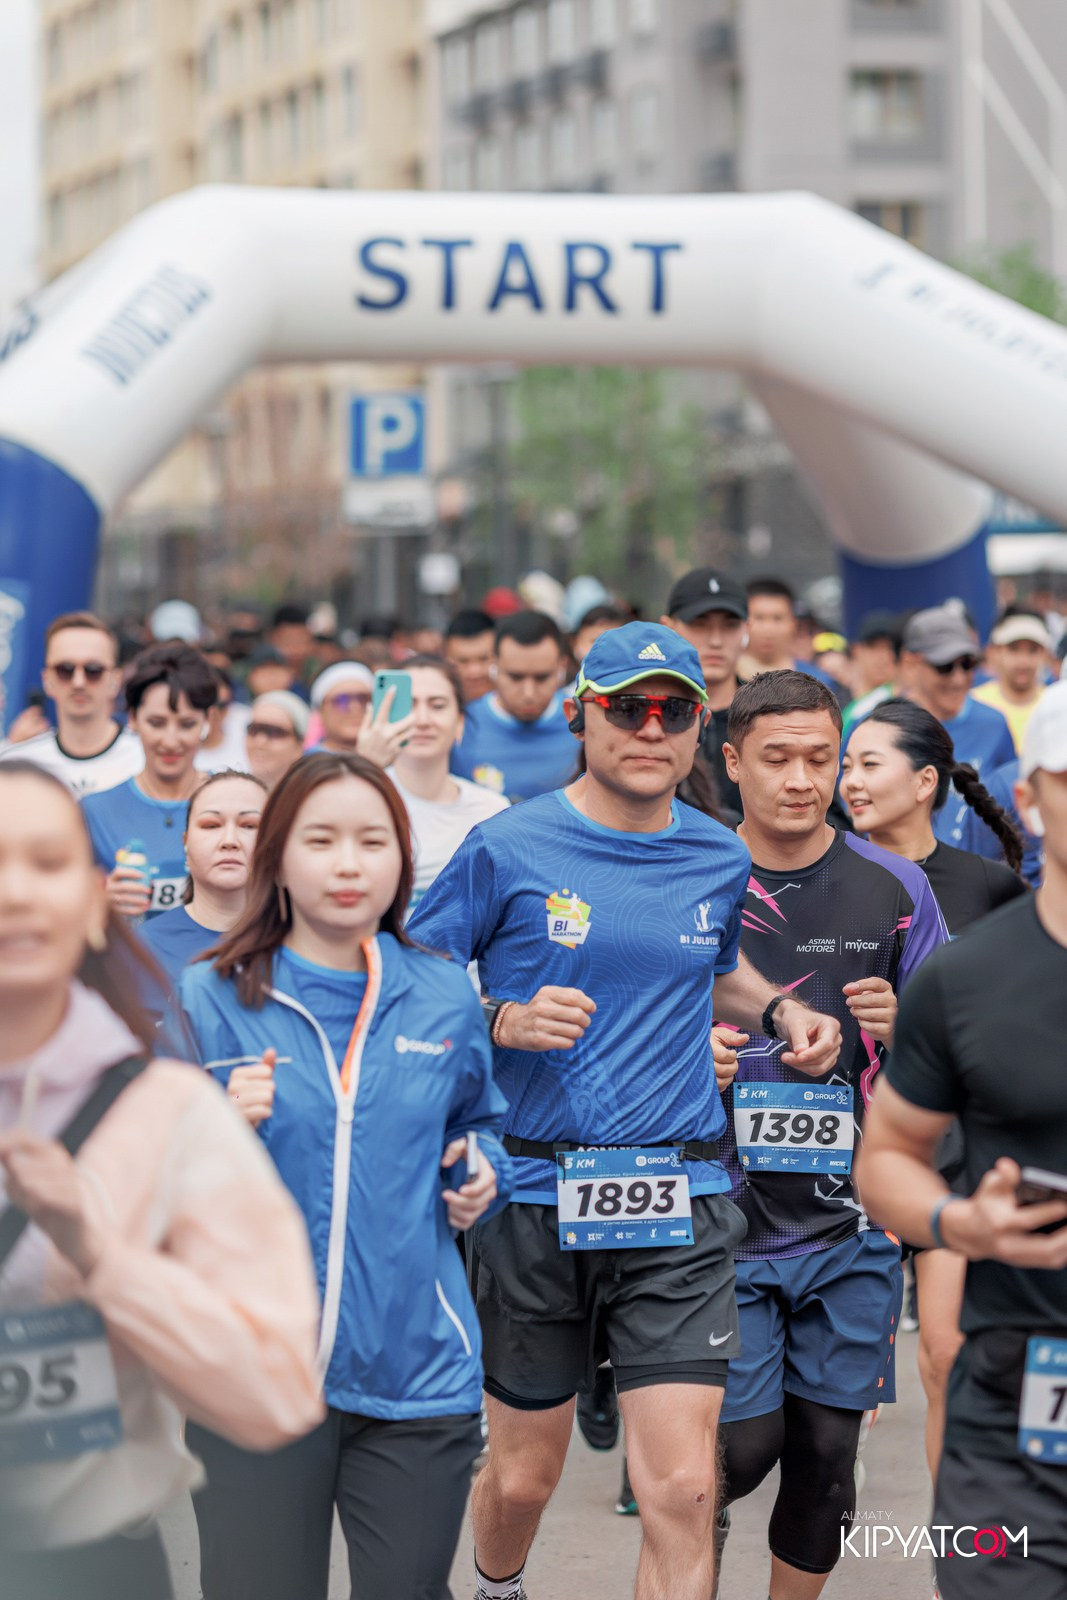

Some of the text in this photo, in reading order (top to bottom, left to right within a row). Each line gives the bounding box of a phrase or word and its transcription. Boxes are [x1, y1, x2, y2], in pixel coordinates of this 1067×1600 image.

[355, 237, 683, 315] START
[365, 397, 417, 475] P
[638, 653, 666, 661] adidas
[553, 920, 568, 931] BI
[679, 934, 690, 944] BI
[739, 1088, 768, 1099] 5 KM
[749, 1112, 840, 1145] 1398
[564, 1157, 596, 1169] 5 KM
[647, 1156, 670, 1164] GROUP
[577, 1180, 677, 1218] 1893
